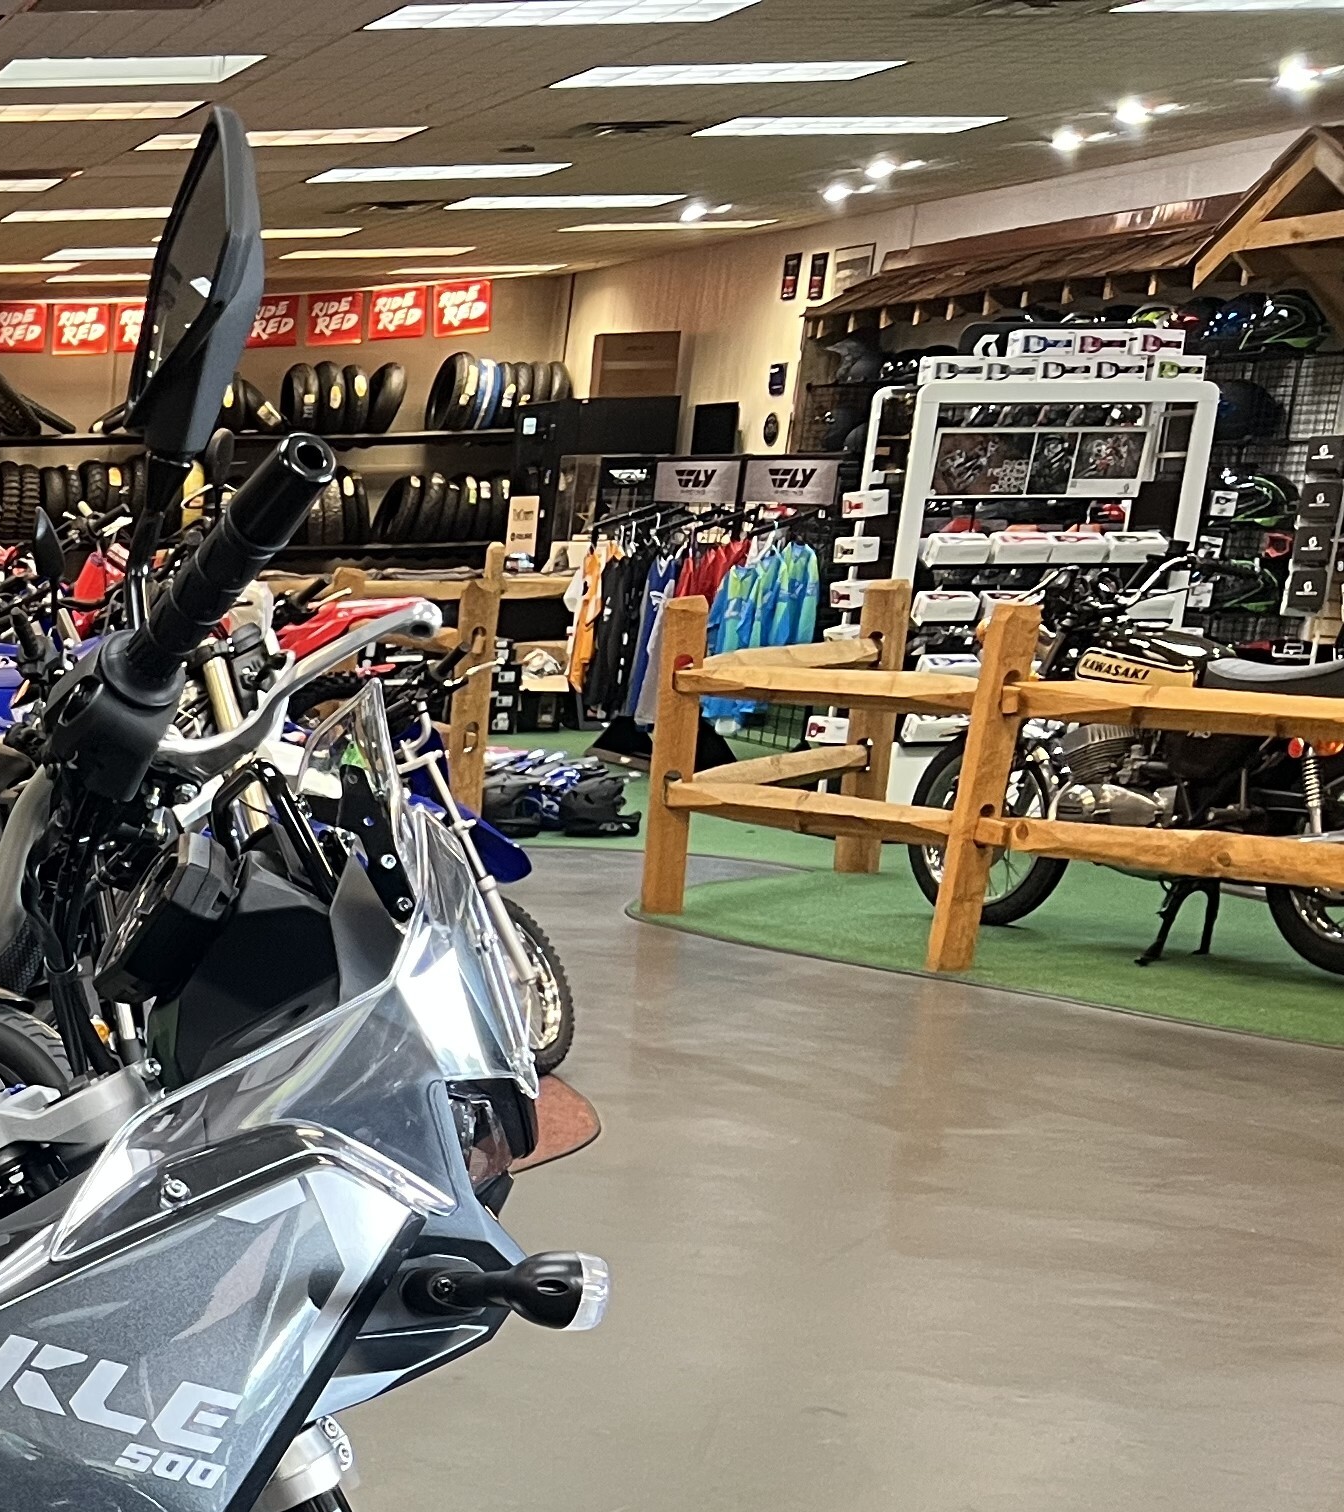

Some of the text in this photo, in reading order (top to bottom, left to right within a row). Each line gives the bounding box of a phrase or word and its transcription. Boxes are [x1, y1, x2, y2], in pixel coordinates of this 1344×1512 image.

[311, 296, 353, 317] RIDE
[374, 291, 417, 312] RIDE
[439, 284, 481, 308] RIDE
[57, 307, 99, 326] RIDE
[314, 312, 359, 336] RED
[377, 307, 423, 332] RED
[443, 301, 488, 327] RED
[61, 323, 107, 346] RED
[251, 317, 295, 340] RED
[674, 468, 718, 488] FLY
[768, 467, 818, 488] FLY
[1081, 658, 1151, 681] KAWASAKI
[113, 1442, 227, 1489] 500
